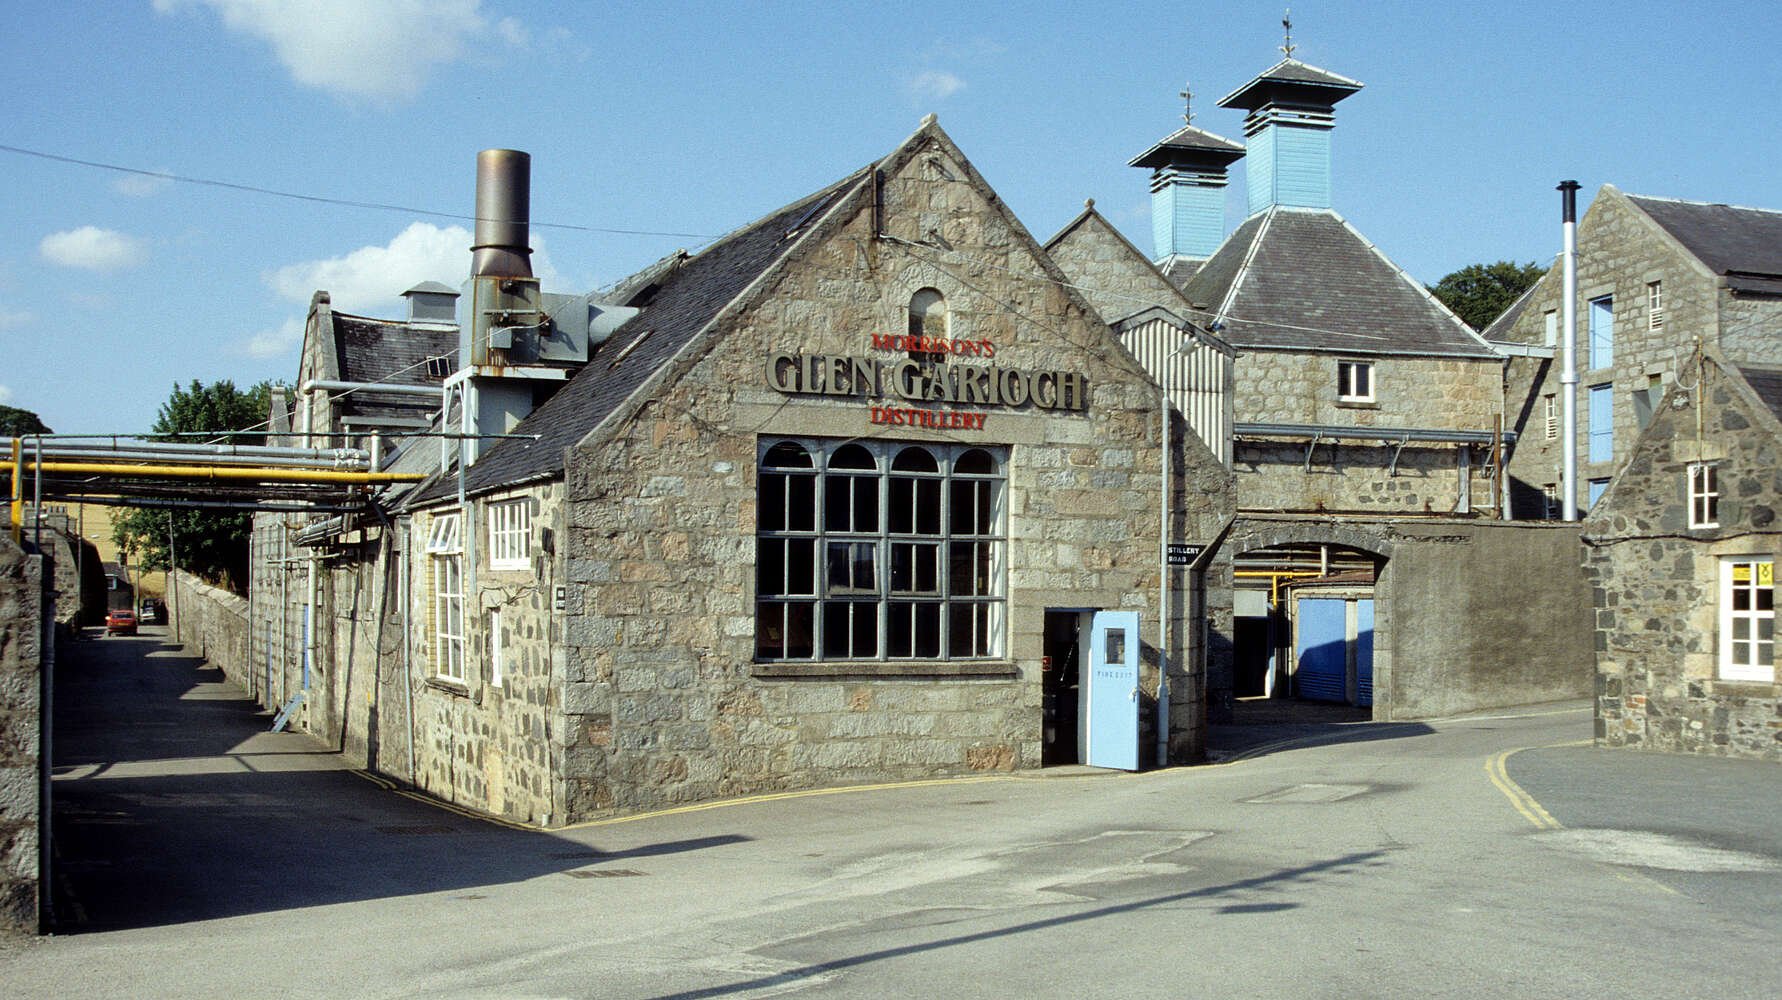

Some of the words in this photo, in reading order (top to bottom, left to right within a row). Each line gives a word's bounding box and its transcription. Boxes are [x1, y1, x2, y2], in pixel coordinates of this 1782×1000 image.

[765, 353, 879, 397] GLEN
[893, 358, 1085, 410] GARIOCH
[871, 406, 987, 430] DISTILLERY
